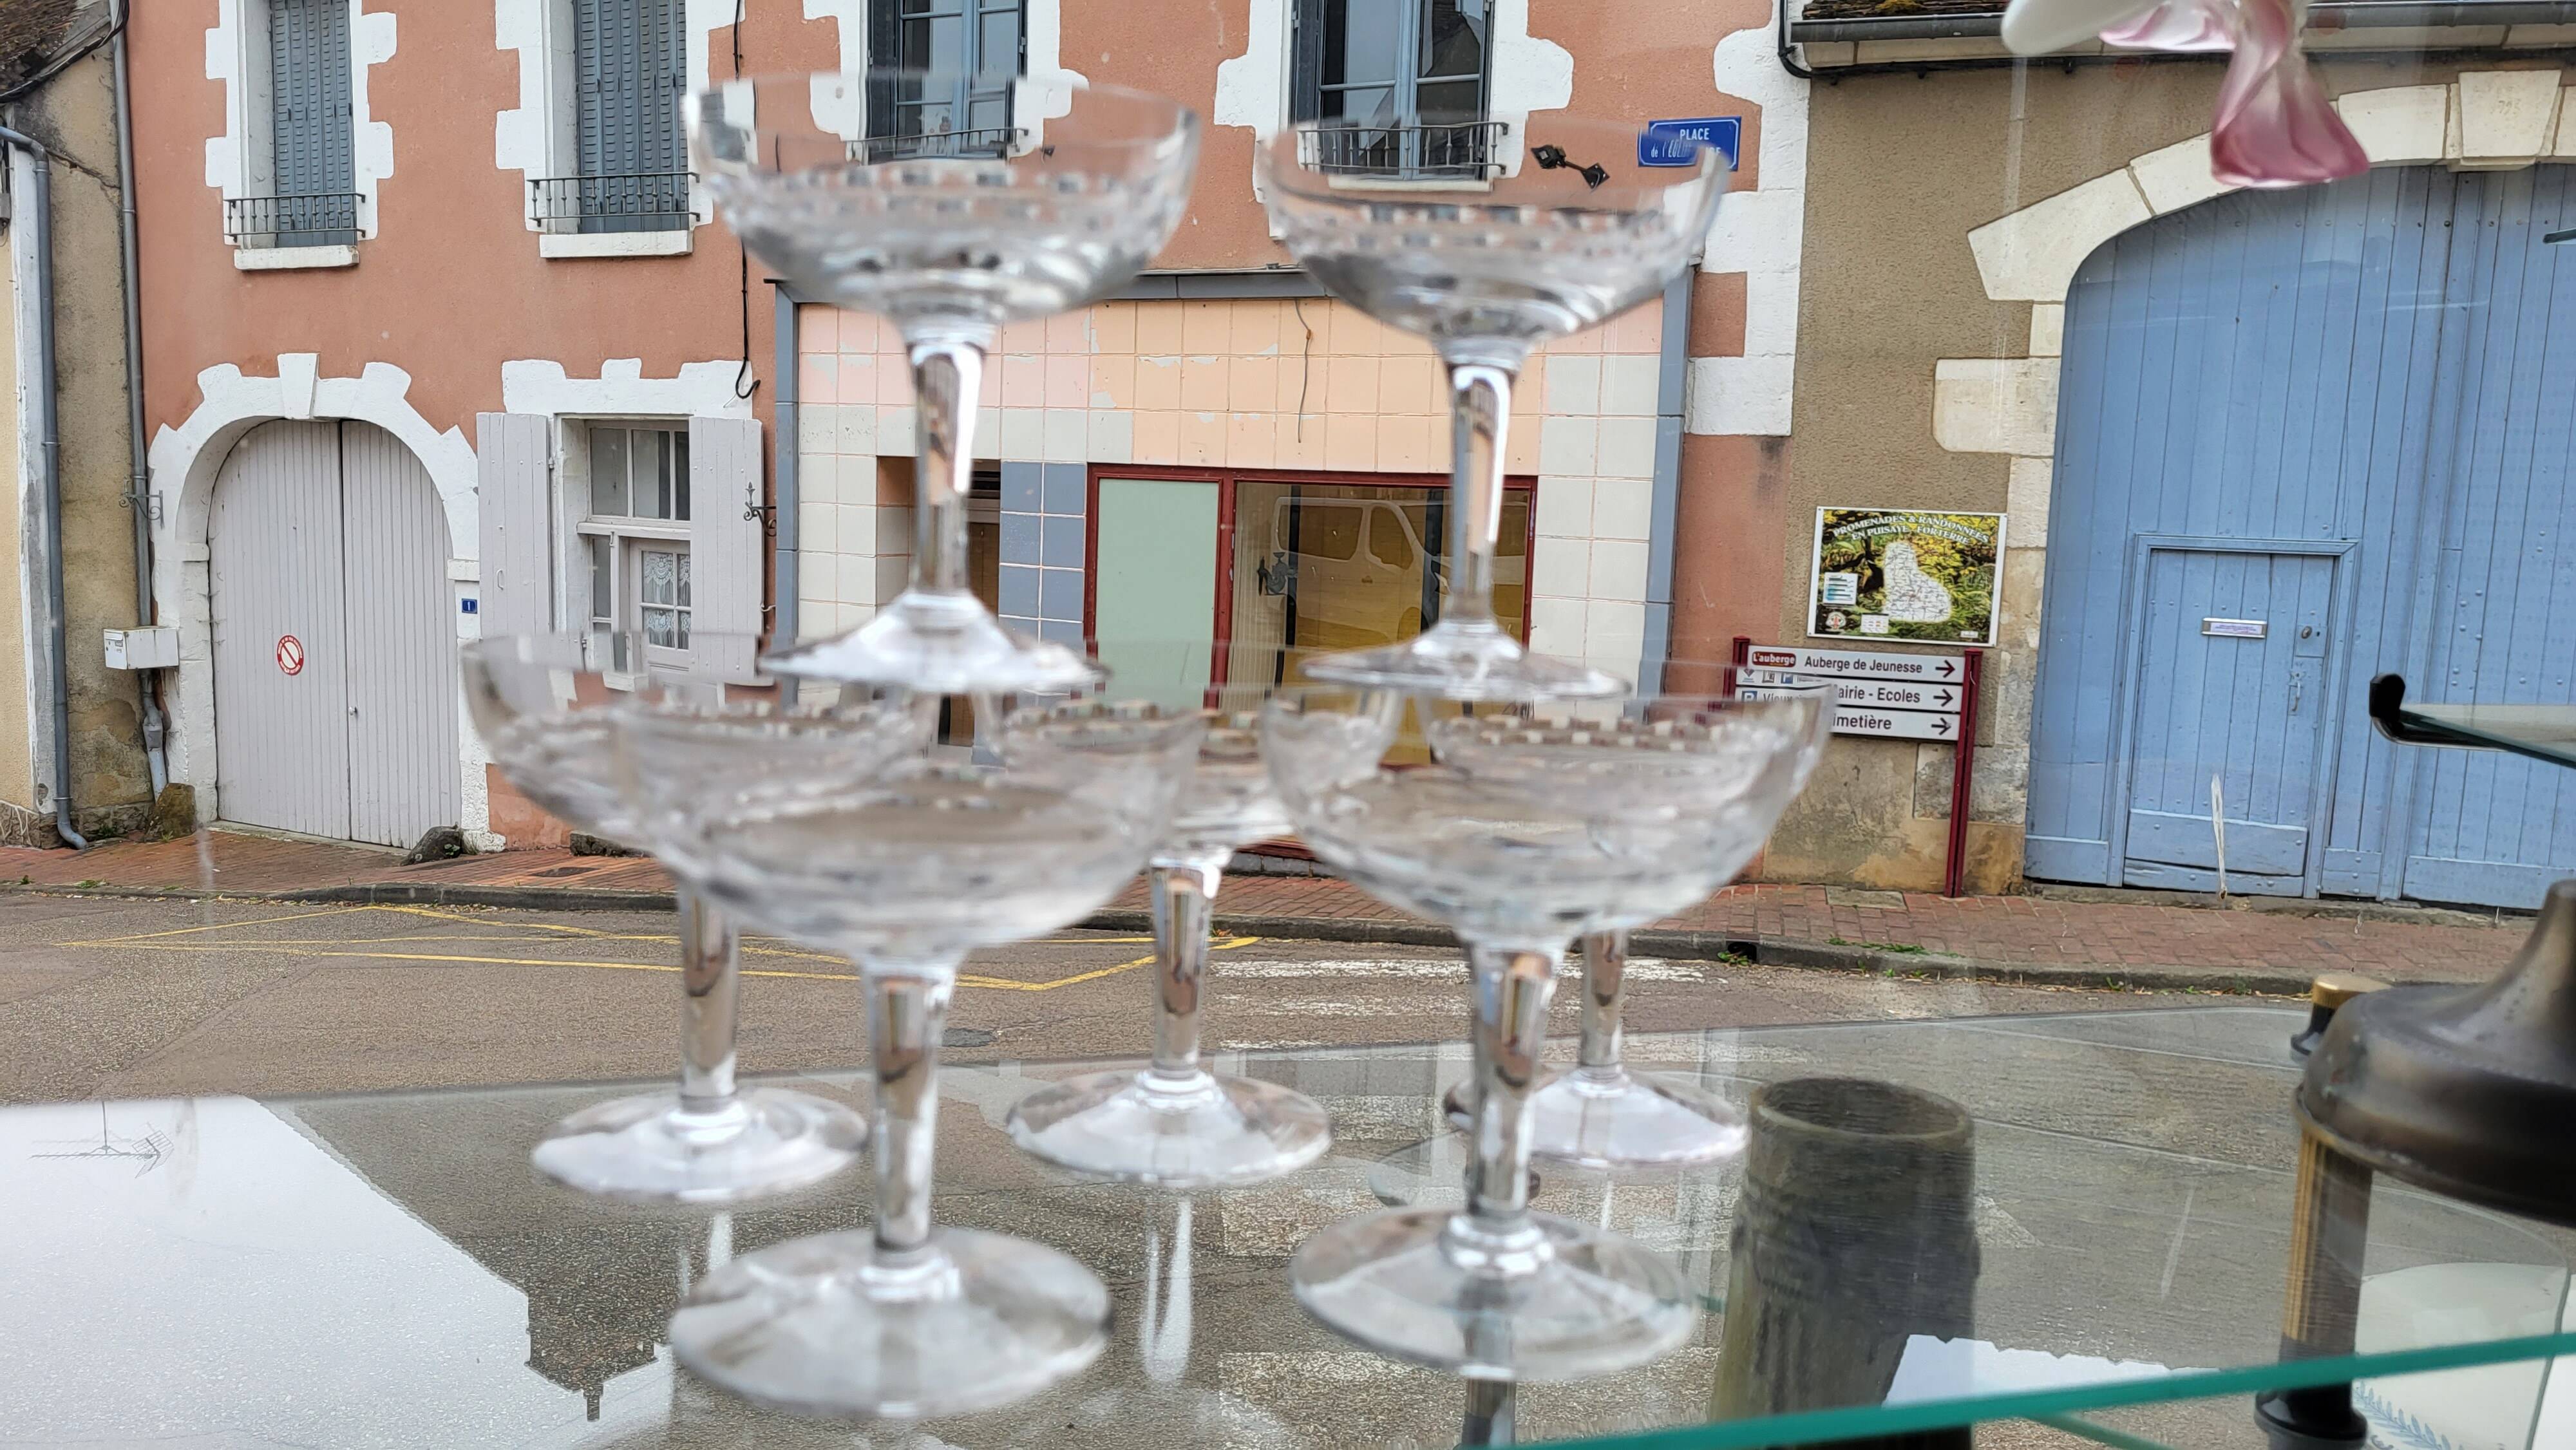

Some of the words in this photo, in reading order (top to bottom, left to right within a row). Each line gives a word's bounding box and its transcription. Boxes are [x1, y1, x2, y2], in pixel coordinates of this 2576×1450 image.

[1680, 128, 1710, 140] PLACE
[1833, 516, 1906, 537] PROMENADES
[1852, 529, 1866, 540] EN
[1868, 525, 1909, 536] PUISAYE
[1917, 526, 1969, 545] FORTERRE
[1753, 652, 1795, 666] L'auberge
[1804, 655, 1850, 672] Auberge
[1853, 658, 1866, 670] de
[1870, 659, 1922, 673] Jeunesse
[1834, 684, 1866, 700] airie
[1877, 688, 1920, 703] Ecoles
[1832, 713, 1892, 730] imetière
